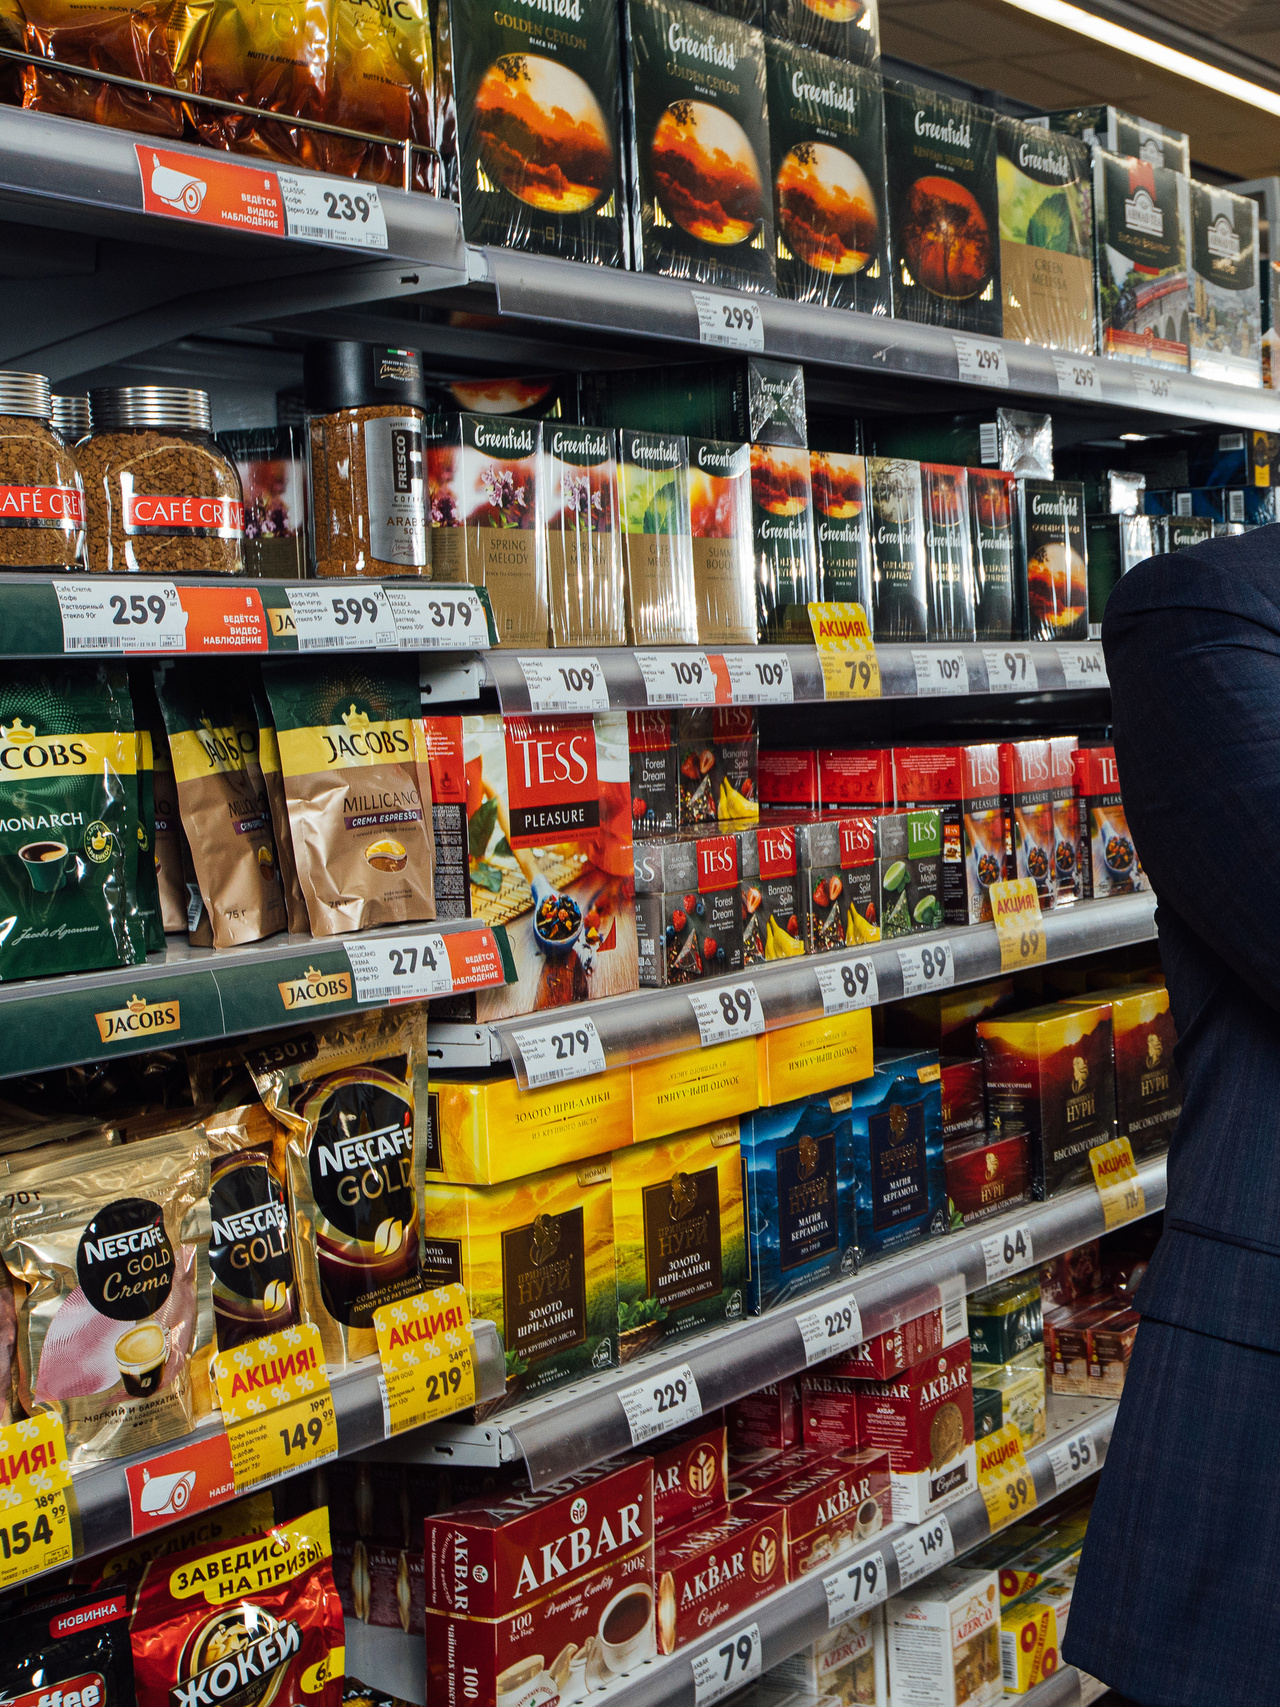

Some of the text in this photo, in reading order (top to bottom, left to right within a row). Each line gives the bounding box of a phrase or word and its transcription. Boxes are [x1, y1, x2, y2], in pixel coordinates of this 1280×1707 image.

[494, 11, 542, 36] GOLDEN
[544, 27, 587, 49] CEYLON
[529, 37, 547, 48] BLACK
[668, 23, 738, 71] Greenfield
[792, 71, 857, 114] Greenfield
[914, 111, 973, 149] Greenfield
[240, 193, 277, 208] ВЕДЁТСЯ
[247, 205, 278, 218] ВИДЕО-
[323, 191, 377, 223] 239 99
[221, 210, 279, 229] НАБЛЮДЕНИЕ
[723, 305, 755, 331] 299
[975, 349, 1000, 371] 299
[1073, 366, 1096, 387] 299
[474, 425, 534, 452] Greenfield
[553, 431, 607, 456] Greenfield
[397, 434, 407, 490] FRESCO
[631, 438, 680, 463] Greenfield
[1032, 495, 1079, 517] Greenfield
[761, 519, 808, 540] Greenfield
[820, 522, 863, 543] Greenfield
[490, 538, 527, 552] SPRING
[488, 552, 529, 566] MELODY
[56, 585, 92, 594] Cafe Creme
[58, 594, 78, 602] Кофе
[60, 602, 105, 612] Растворимый
[62, 612, 85, 620] стекло
[109, 588, 177, 625] 259 99
[293, 606, 328, 615] Растворимый
[332, 591, 385, 626] 599 99
[428, 596, 479, 627] 379 99
[223, 614, 261, 625] ВЕДЁТСЯ
[230, 626, 261, 636] ВИДЕО-
[819, 619, 867, 639] АКЦИЯ!
[203, 635, 263, 646] НАБЛЮДЕНИЕ
[1003, 652, 1026, 681] 97
[322, 729, 410, 764] JACOBS
[722, 749, 749, 759] Banana
[515, 735, 588, 788] TESS
[645, 757, 666, 770] Forest
[734, 758, 749, 771] Split
[968, 758, 1001, 788] TESS
[1018, 752, 1049, 783] TESS
[642, 769, 666, 782] Dream
[343, 789, 420, 814] MILLICANO
[971, 798, 1000, 811] PLEASURE
[1021, 792, 1050, 805] PLEASURE
[352, 810, 418, 828] CREMA ESPRESSO
[524, 809, 585, 829] PLEASURE
[842, 827, 870, 852] TESS
[910, 819, 937, 844] TESS
[700, 846, 734, 875] TESS
[761, 838, 793, 863] TESS
[848, 873, 871, 885] Banana
[918, 862, 937, 875] Ginger
[920, 874, 937, 885] Mojito
[768, 884, 793, 895] Banana
[858, 882, 871, 895] Split
[714, 896, 734, 908] Forest
[779, 894, 794, 907] Split
[996, 893, 1036, 916] АКЦИЯ!
[712, 908, 734, 921] Dream
[1019, 929, 1039, 959] 69
[388, 939, 444, 976] 274 99
[465, 952, 495, 965] ВЕДЁТСЯ
[471, 963, 497, 974] ВИДЕО-
[353, 966, 379, 974] ESPRESSO
[452, 972, 499, 987] НАБЛЮДЕНИЕ
[286, 978, 348, 1006] JACOBS
[104, 1006, 176, 1038] JACOBS
[551, 1022, 594, 1060] 279 99
[986, 1081, 1033, 1090] ВЫСОКОГОРНЫЙ
[1140, 1074, 1170, 1097] НУРИ
[514, 1091, 611, 1124] ЗОЛОТО ШРИ-ЛАНКИ
[1066, 1099, 1096, 1124] НУРИ
[1053, 1131, 1110, 1162] ВЫСОКОГОРНЫЙ
[584, 1166, 607, 1180] НОВЫЙ
[1097, 1151, 1132, 1178] АКЦИЯ!
[883, 1185, 919, 1204] БЕРГАМОТА
[889, 1175, 912, 1191] МАГИЯ
[981, 1183, 1005, 1204] НУРИ
[791, 1220, 829, 1242] БЕРГАМОТА
[798, 1211, 822, 1228] МАГИЯ
[658, 1226, 709, 1258] НУРИ
[1003, 1230, 1027, 1264] 64
[127, 1248, 171, 1276] GOLD
[668, 1252, 701, 1272] ЗОЛОТО
[658, 1261, 711, 1287] ШРИ-ЛАНКИ
[103, 1270, 171, 1303] Crema
[518, 1268, 571, 1306] НУРИ
[528, 1299, 563, 1321] ЗОЛОТО
[389, 1306, 464, 1350] АКЦИЯ!
[516, 1308, 575, 1338] ШРИ-ЛАНКИ
[448, 1350, 463, 1363] 349
[231, 1346, 317, 1398] АКЦИЯ!
[426, 1359, 471, 1403] 219 99
[653, 1369, 692, 1413] 229 99
[803, 1376, 852, 1394] AKBAR
[860, 1383, 911, 1399] AKBAR
[919, 1364, 968, 1407] AKBAR
[310, 1399, 325, 1413] 199
[230, 1424, 267, 1442] Кофе Nescafe
[279, 1408, 334, 1457] 149 99
[234, 1454, 261, 1468] молотого
[979, 1438, 1020, 1474] АКЦИЯ!
[1068, 1435, 1091, 1472] 55
[815, 1477, 872, 1527] AKBAR
[1005, 1477, 1028, 1511] 39
[0, 1504, 66, 1559] 154 99
[512, 1502, 644, 1600] AKBAR
[176, 1536, 291, 1591] ЗАВЕДИСЬ
[217, 1541, 325, 1599] НА ПРИЗЫ!
[453, 1530, 470, 1612] AKBAR
[680, 1551, 746, 1607] AKBAR
[57, 1603, 118, 1630] НОВИНКА
[510, 1612, 533, 1634] 100
[569, 1604, 590, 1623] Tea
[508, 1626, 535, 1643] Tea Bags
[173, 1618, 300, 1707] ЖОКЕЙ
[463, 1665, 479, 1699] 100
